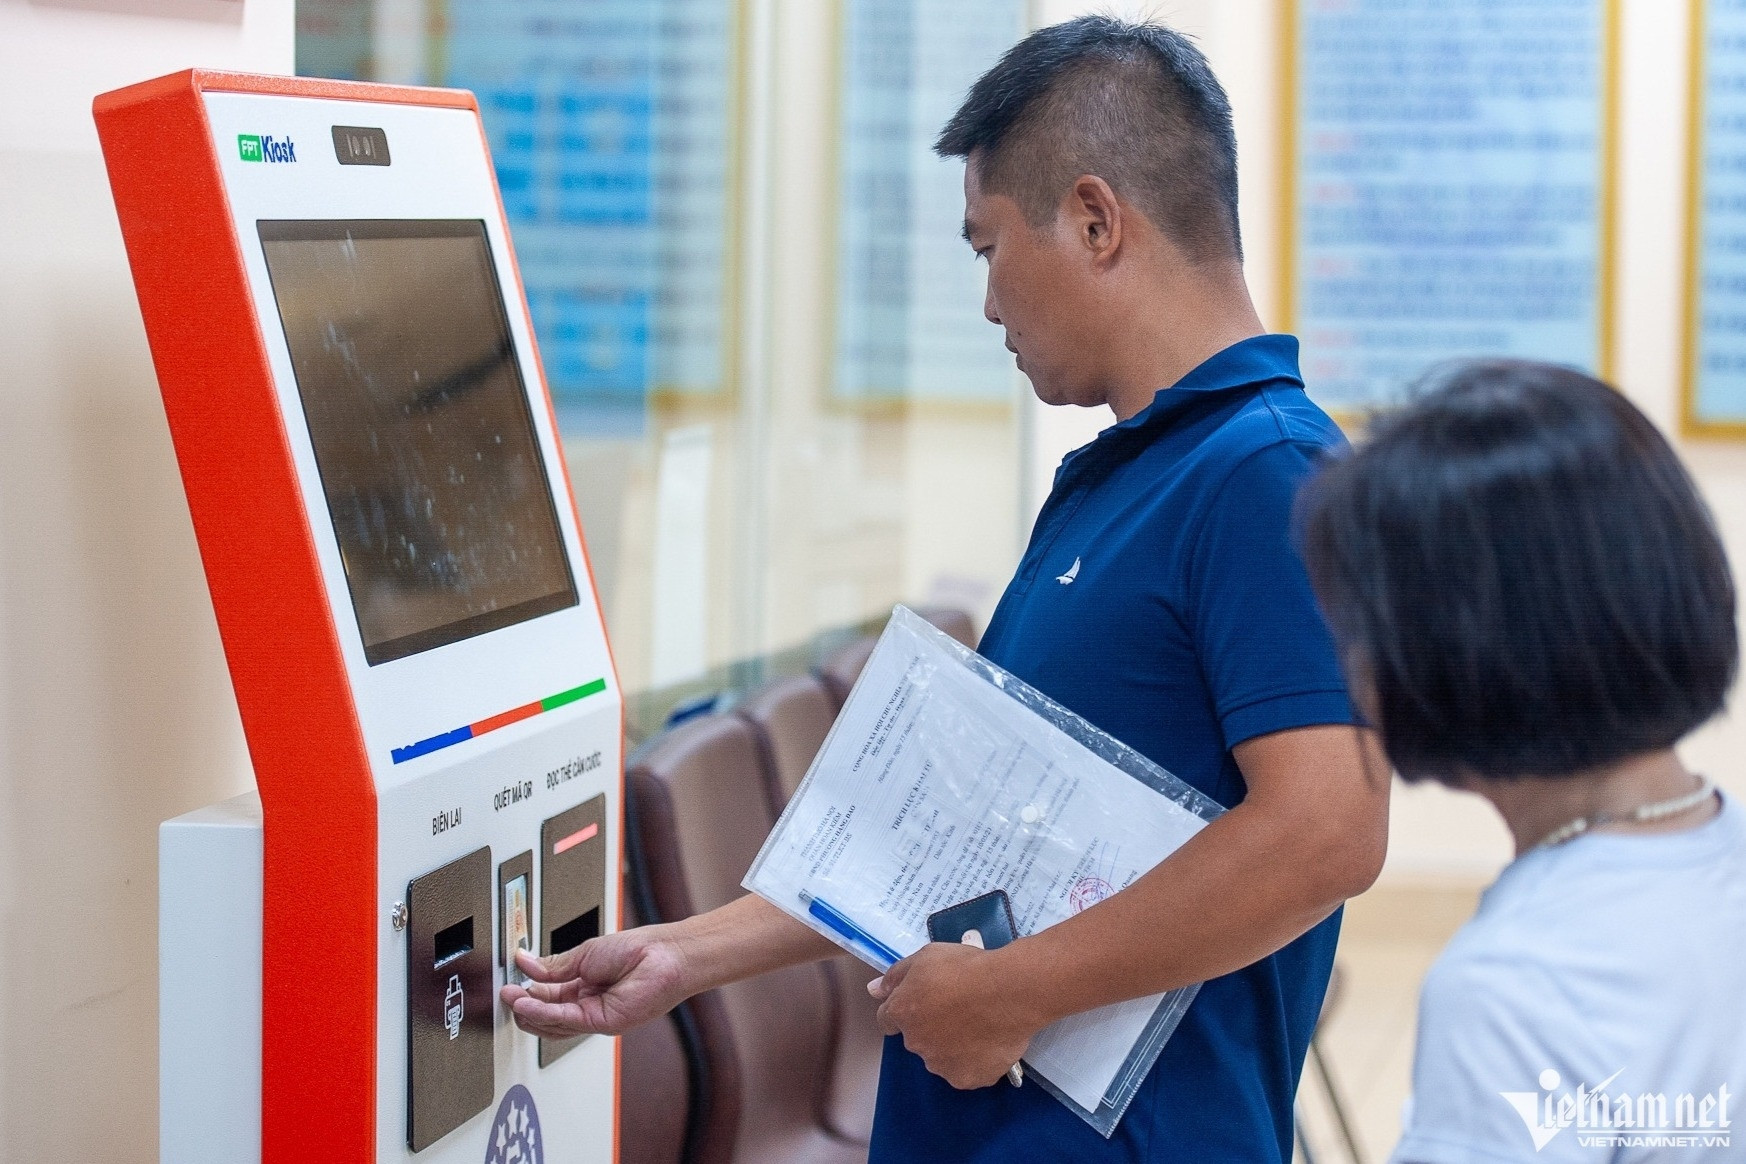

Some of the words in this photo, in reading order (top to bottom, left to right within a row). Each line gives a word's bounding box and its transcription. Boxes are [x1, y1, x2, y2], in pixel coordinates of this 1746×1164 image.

[240, 138, 260, 158] FPT
[261, 135, 297, 163] Kiosk
[493, 786, 511, 812] QUÉT
[511, 780, 523, 805] MÃ
[523, 780, 533, 800] QR
[891, 807, 908, 831] TRÍCH
[904, 791, 916, 808] LỤC
[432, 811, 449, 836] BIÊN
[450, 807, 462, 828] LAI
